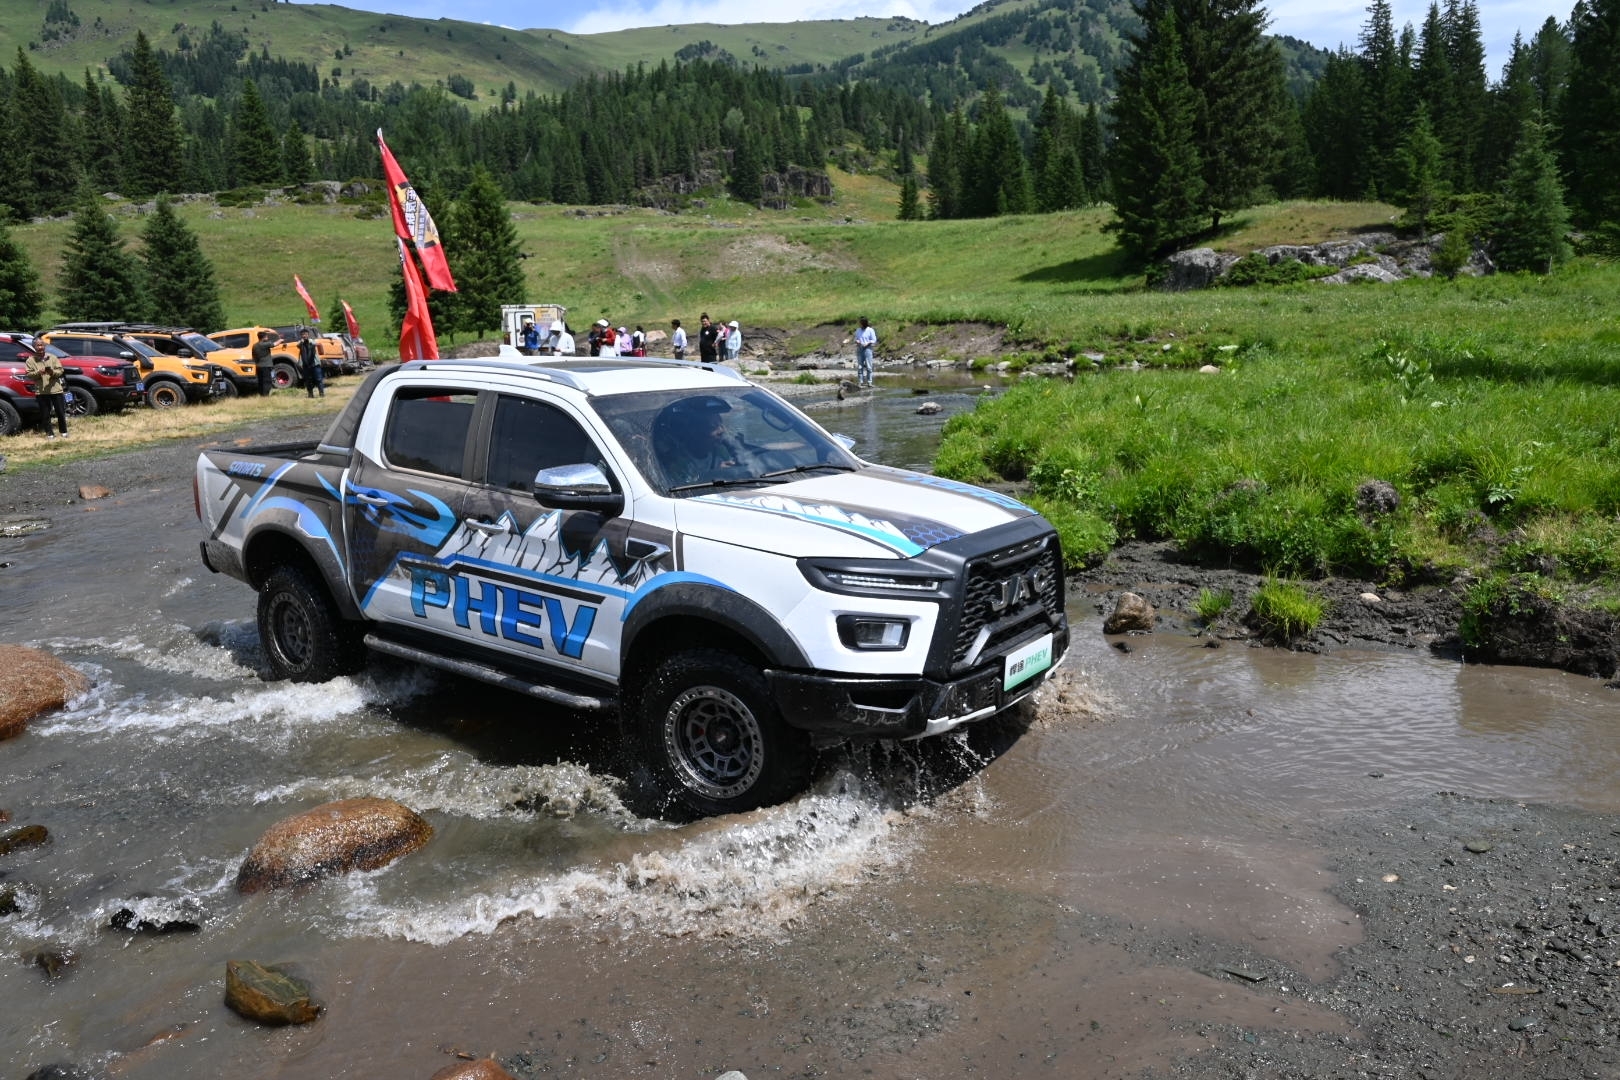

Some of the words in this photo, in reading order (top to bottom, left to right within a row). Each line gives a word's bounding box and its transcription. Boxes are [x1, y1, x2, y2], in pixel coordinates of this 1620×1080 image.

[991, 567, 1049, 612] JAC
[409, 566, 598, 660] PHEV
[1025, 647, 1048, 666] PHEV
